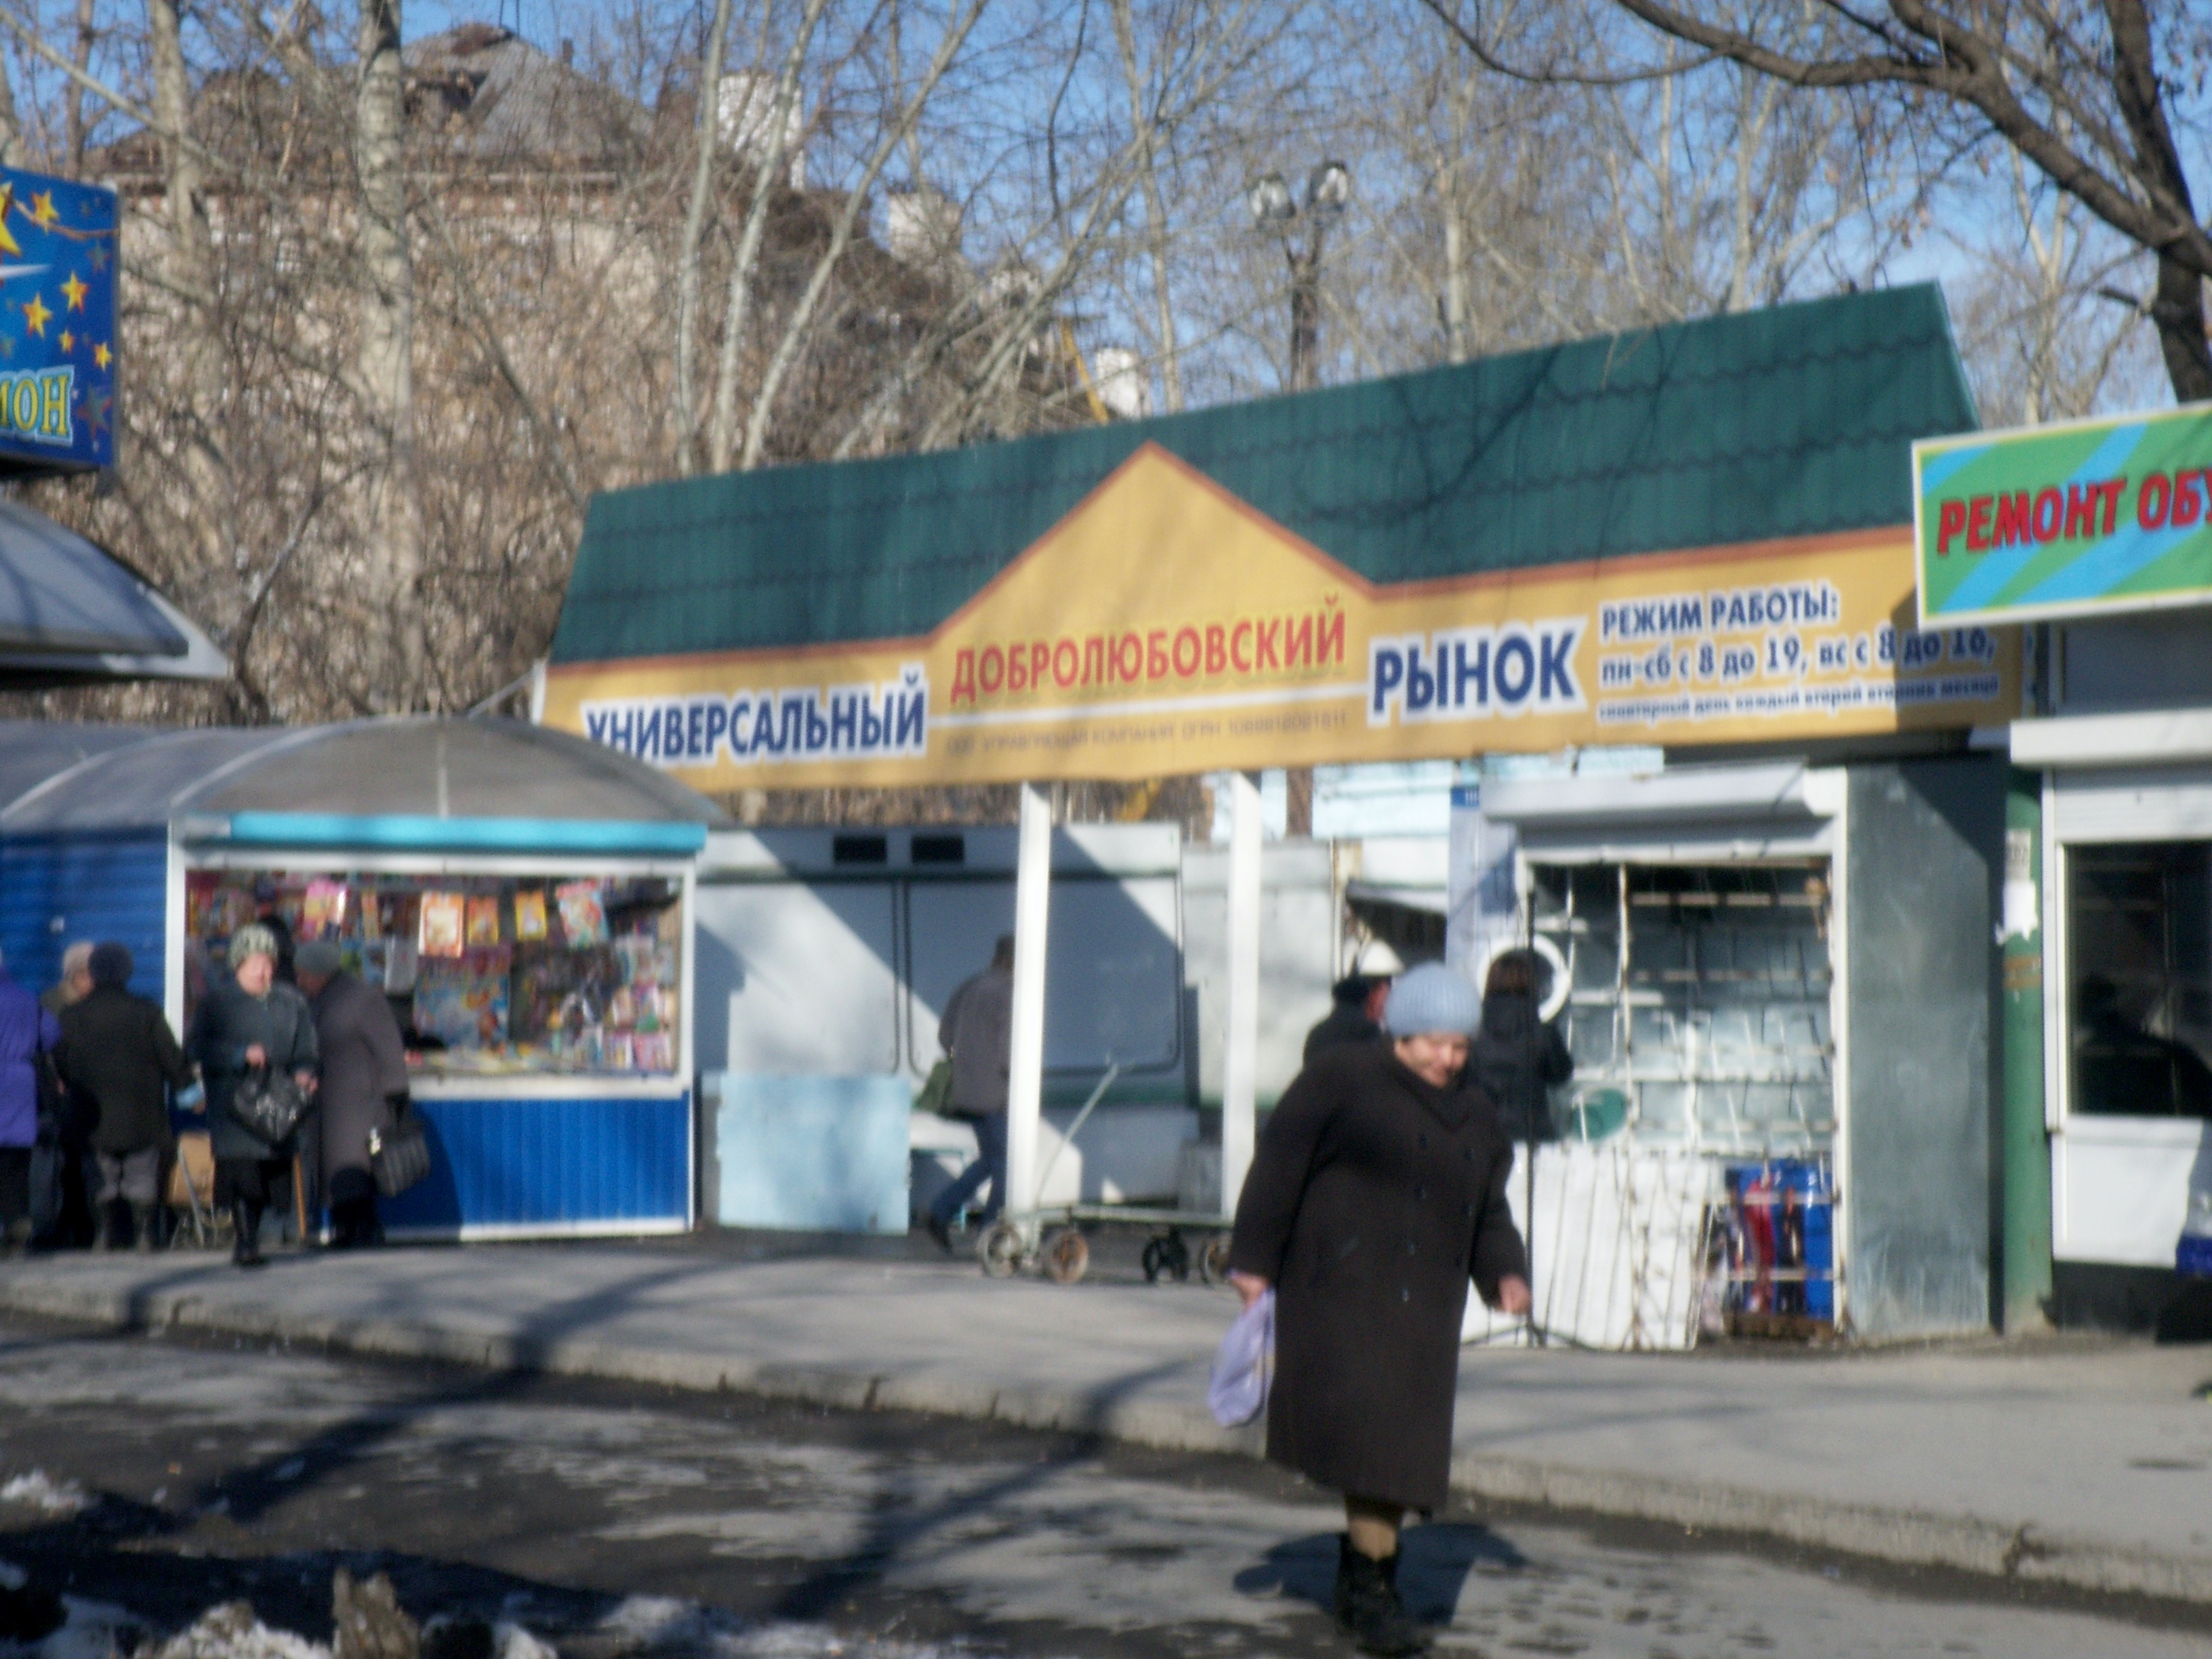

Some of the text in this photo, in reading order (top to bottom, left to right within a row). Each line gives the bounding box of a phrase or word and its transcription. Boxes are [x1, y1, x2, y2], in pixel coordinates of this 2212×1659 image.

[0, 375, 68, 435] ОН
[1937, 476, 2127, 556] РЕМОНТ
[950, 593, 1347, 706] ДОБРОЛЮБОВСКИЙ
[1601, 588, 1839, 636] РЕЖИМ РАБОТЫ:
[1372, 630, 1576, 716] РЫНОК
[1602, 644, 1672, 680] пн-сб
[1679, 653, 1690, 677] с
[1699, 644, 1715, 676] 8
[1723, 651, 1756, 677] до
[1767, 637, 1807, 675] 19,
[1819, 639, 1847, 665] вс
[1854, 638, 1869, 665] с
[1879, 629, 1896, 660] 8
[1903, 632, 1942, 665] до
[586, 670, 925, 763] УНИВЕРСАЛЬНЫЙ
